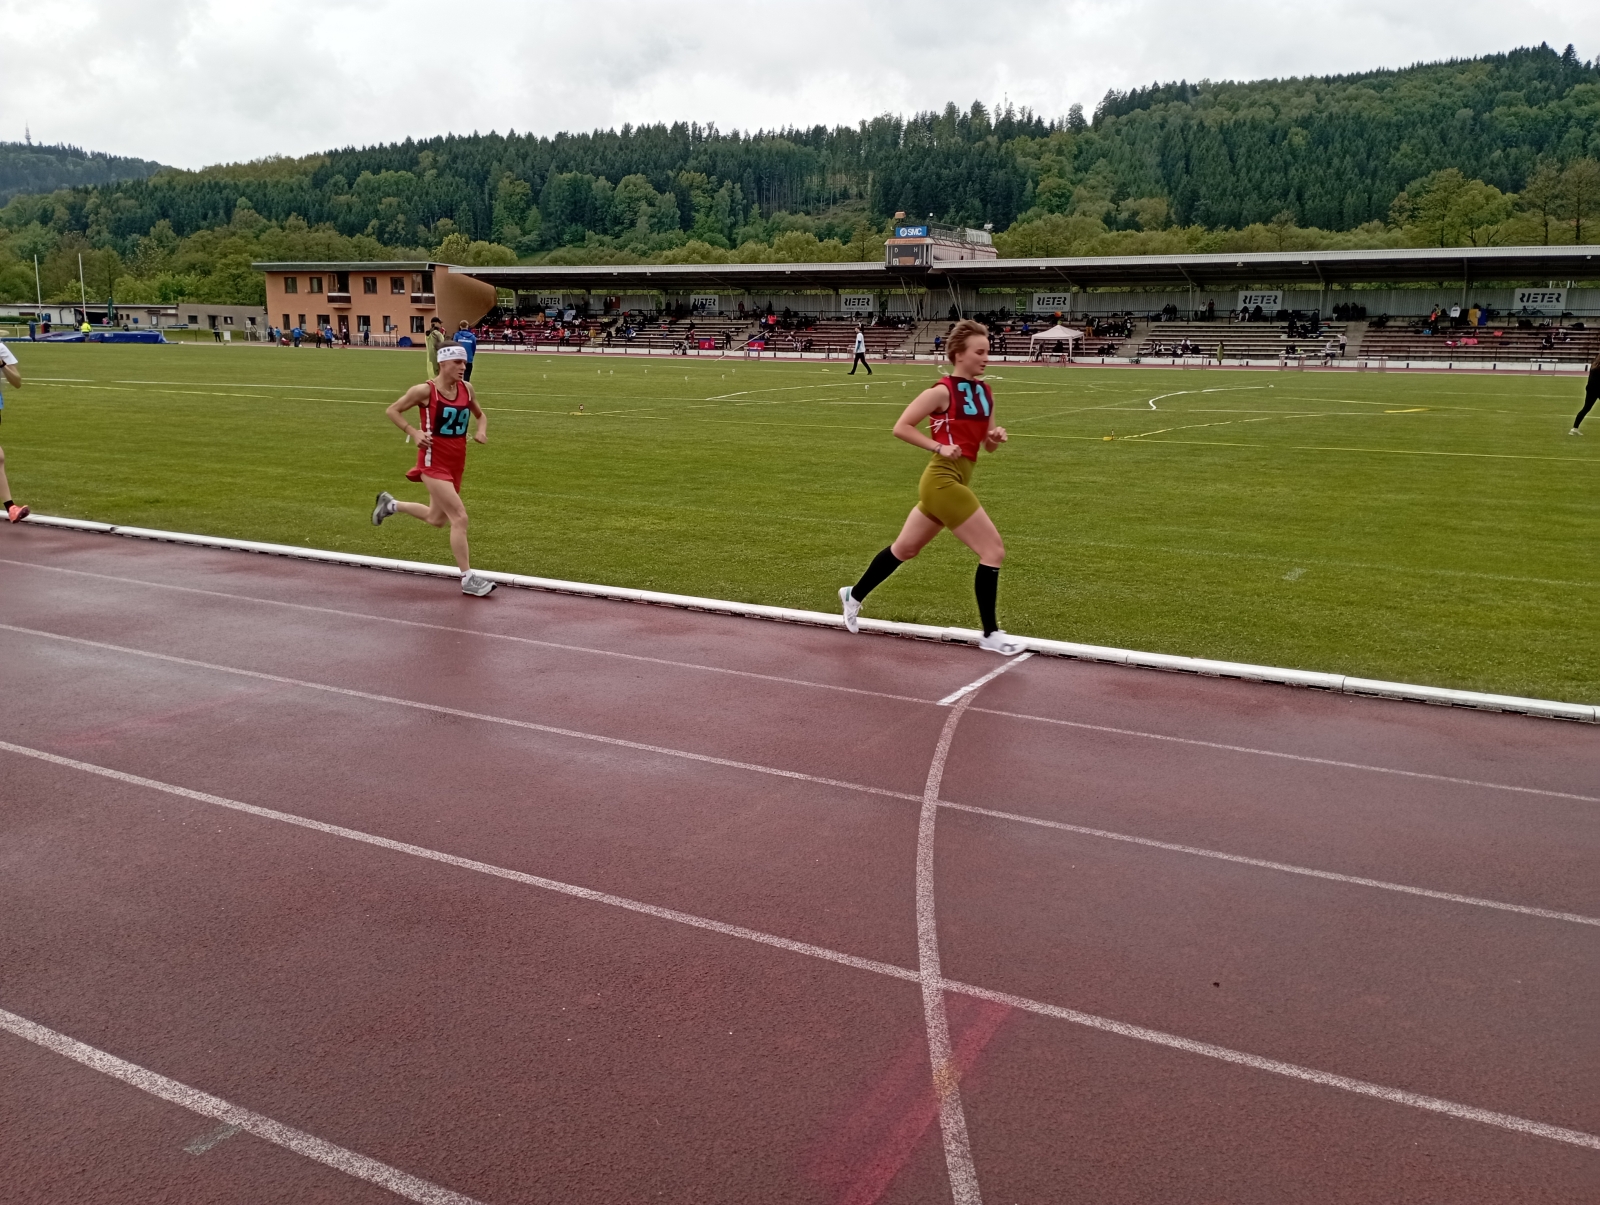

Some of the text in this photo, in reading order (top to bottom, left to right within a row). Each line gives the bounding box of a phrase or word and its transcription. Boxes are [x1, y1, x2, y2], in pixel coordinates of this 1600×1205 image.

[907, 228, 922, 236] SMC
[844, 297, 870, 306] RIETER
[1036, 296, 1067, 306] RIETER
[1242, 294, 1278, 305] RIETER
[1519, 292, 1562, 303] RIETER
[957, 382, 990, 417] 31
[440, 406, 470, 435] 29
